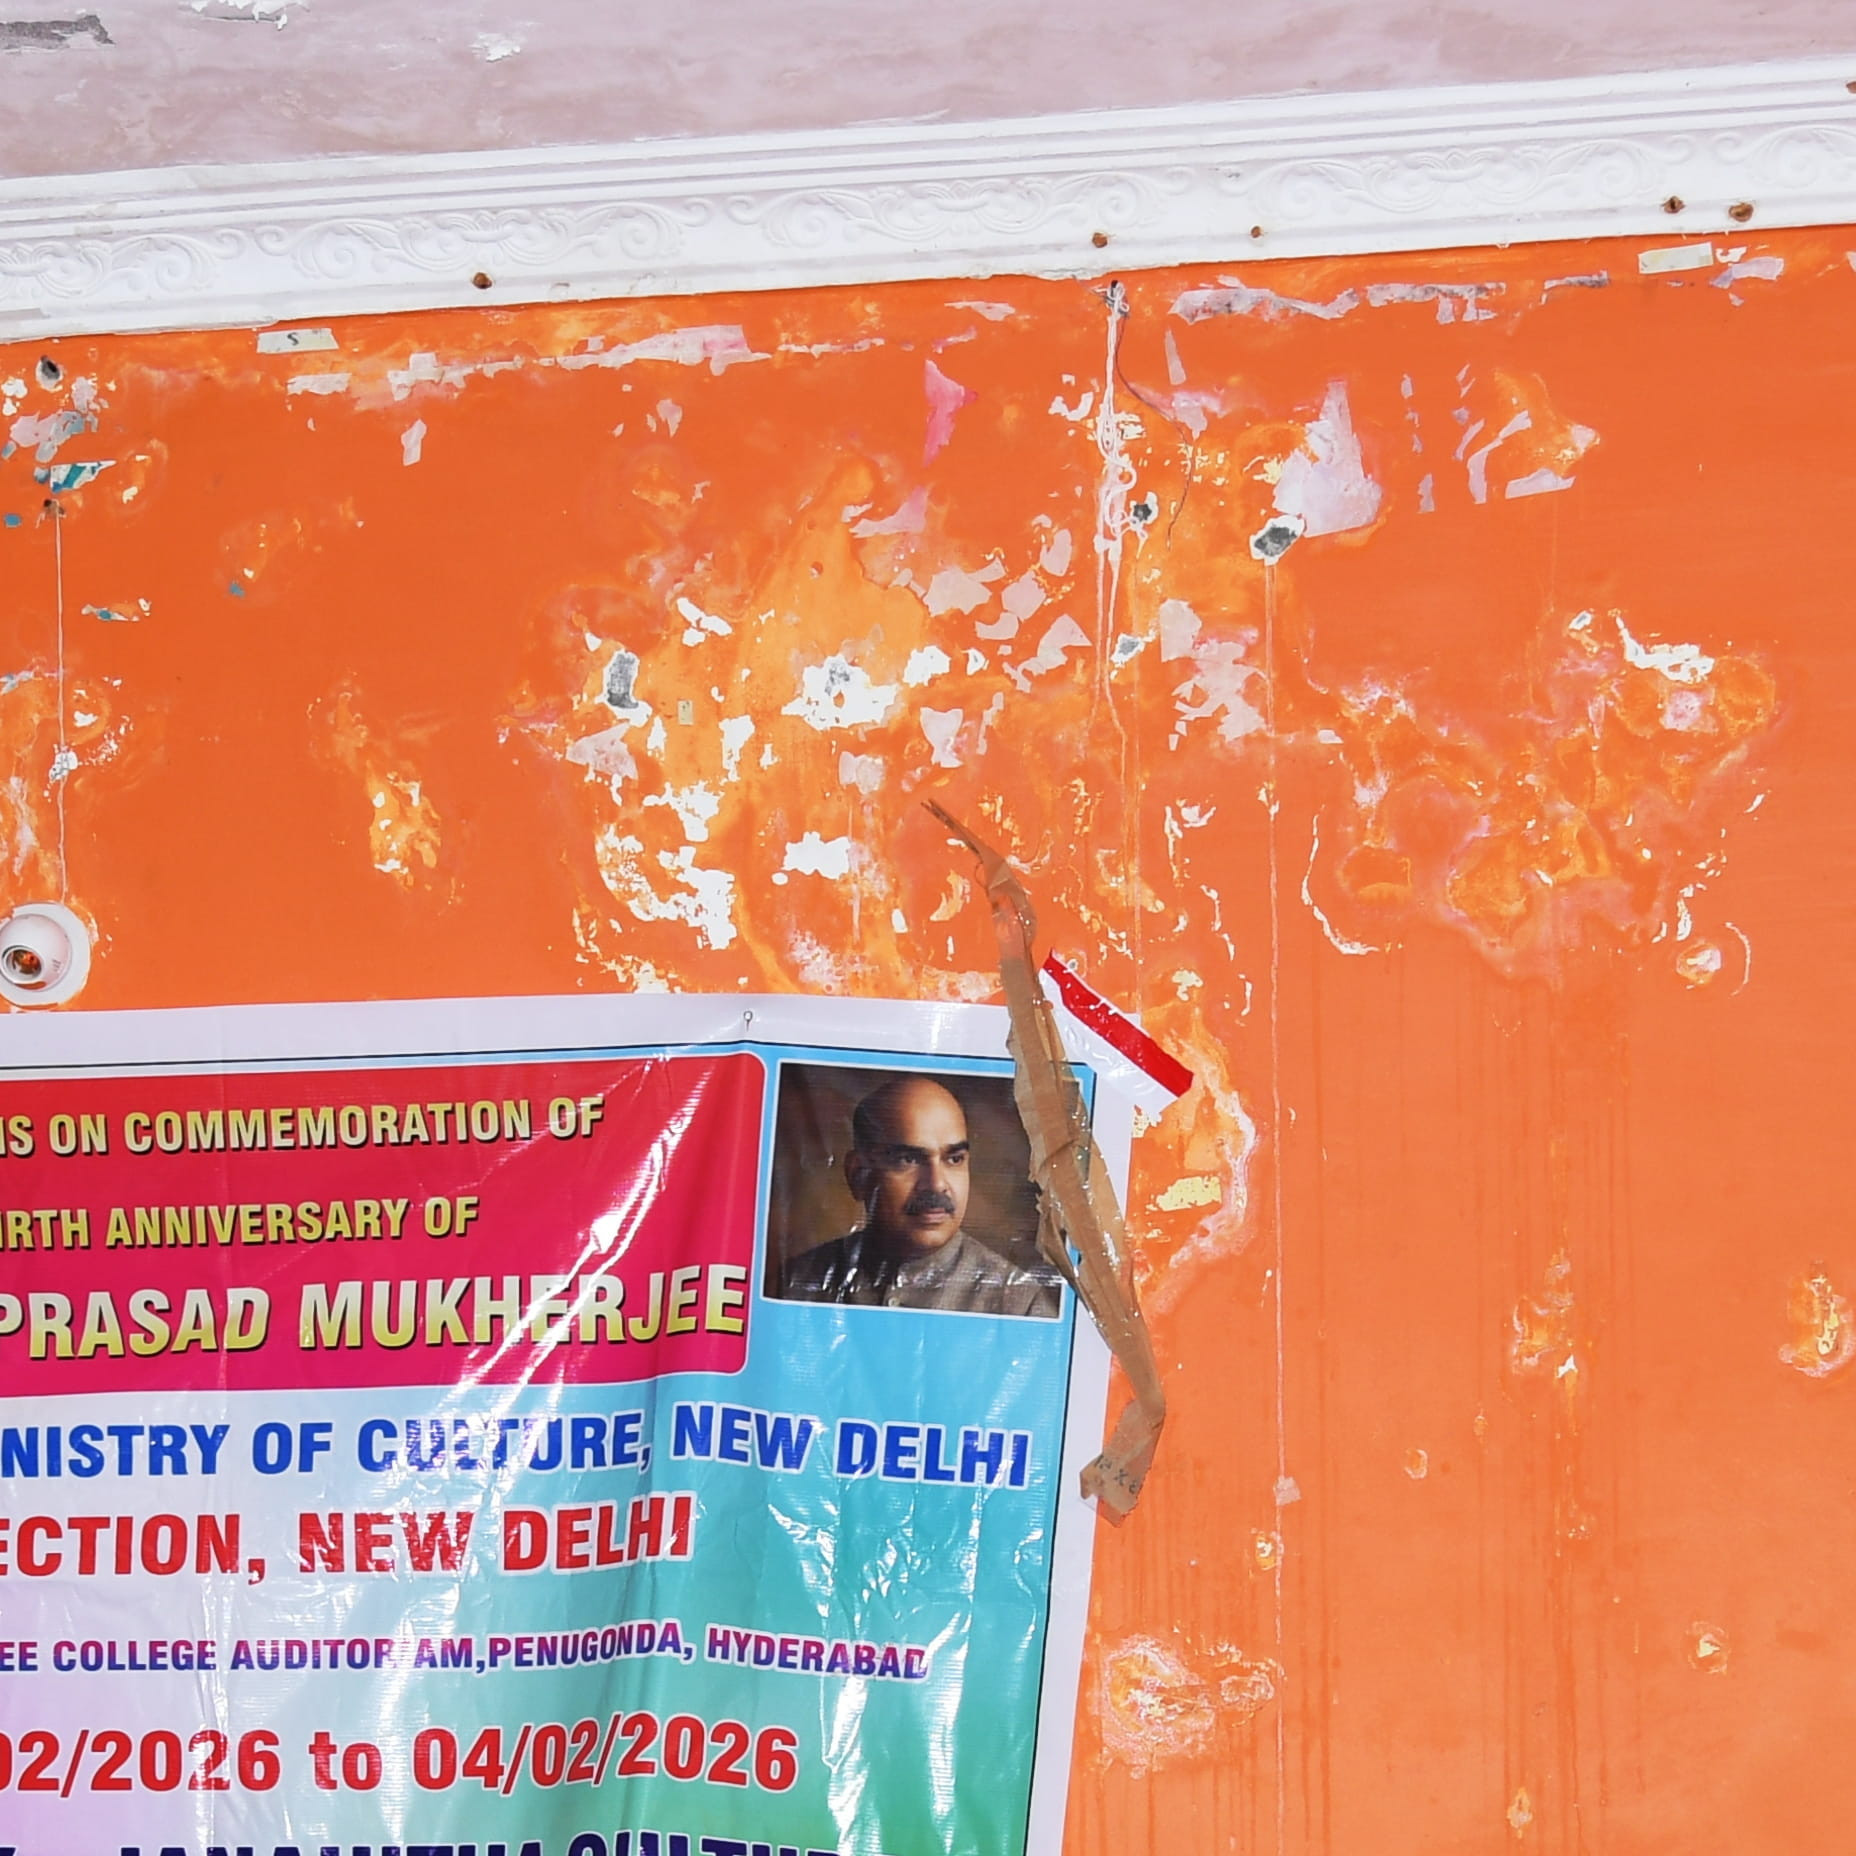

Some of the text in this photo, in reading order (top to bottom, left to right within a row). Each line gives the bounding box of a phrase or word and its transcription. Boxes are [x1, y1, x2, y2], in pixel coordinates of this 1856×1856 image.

[49, 1113, 110, 1158] ON
[125, 1098, 533, 1155] COMMEMORATION
[550, 1095, 605, 1137] OF
[106, 1198, 412, 1248] ANNIVERSARY
[425, 1195, 480, 1238] OF
[300, 1264, 748, 1350] MUKHERJEE
[251, 1420, 334, 1476] OF
[357, 1414, 652, 1475] CULTURE,
[673, 1404, 814, 1471] NEW
[835, 1420, 1030, 1487] DELHI
[298, 1509, 476, 1575] NEW
[504, 1496, 692, 1571] DELHI
[53, 1638, 217, 1674] COLLEGE
[708, 1625, 930, 1680] HYDERABAD
[309, 1729, 381, 1791] to
[413, 1711, 799, 1793] 04/02/2026
